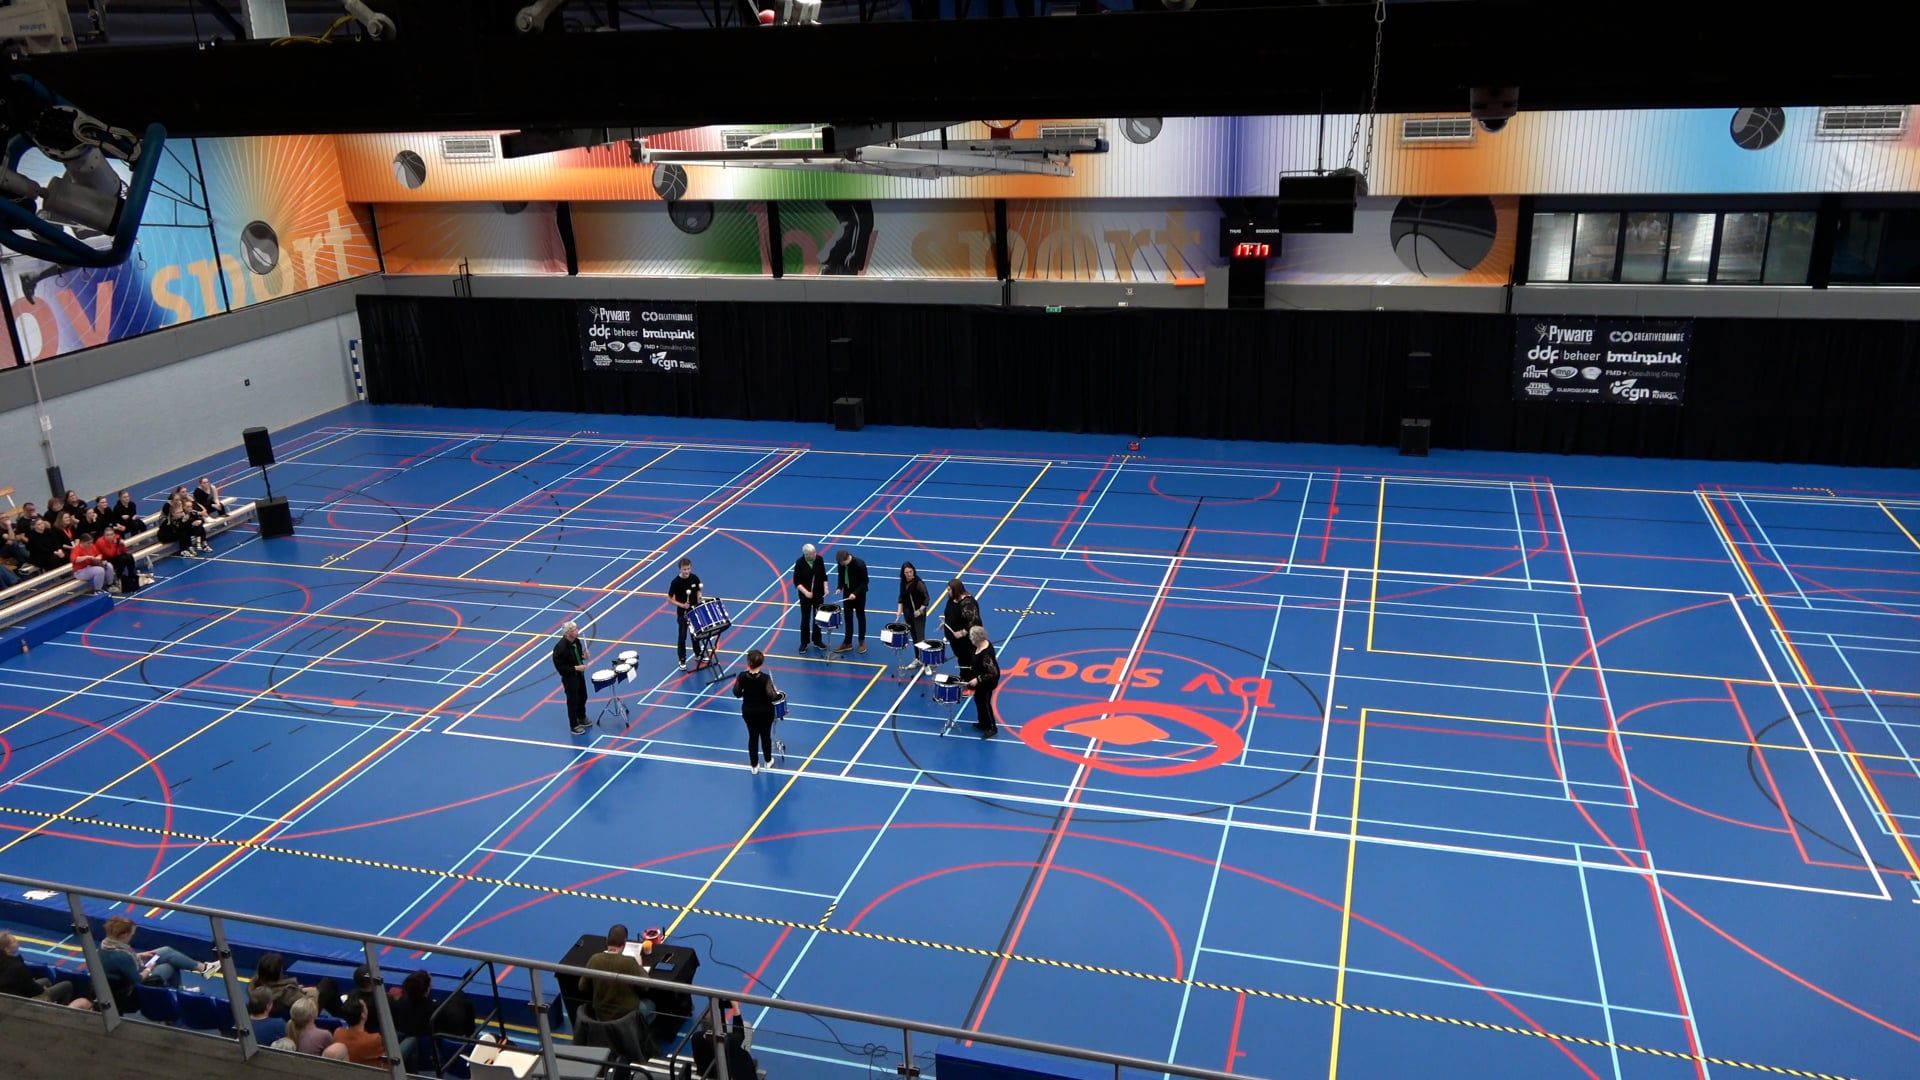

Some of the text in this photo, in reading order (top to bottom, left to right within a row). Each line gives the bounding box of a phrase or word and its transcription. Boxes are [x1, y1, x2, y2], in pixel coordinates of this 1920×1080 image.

[1237, 245, 1268, 256] 17:17
[599, 307, 632, 323] Pyware
[589, 323, 639, 340] ddf beheer
[642, 328, 696, 341] brainpink
[1548, 325, 1594, 344] Pyware
[1527, 345, 1601, 364] ddf beheer
[1606, 351, 1683, 366] brainpink
[658, 359, 678, 371] cgn
[1621, 387, 1650, 401] cgn
[1000, 656, 1275, 708] bv spor
